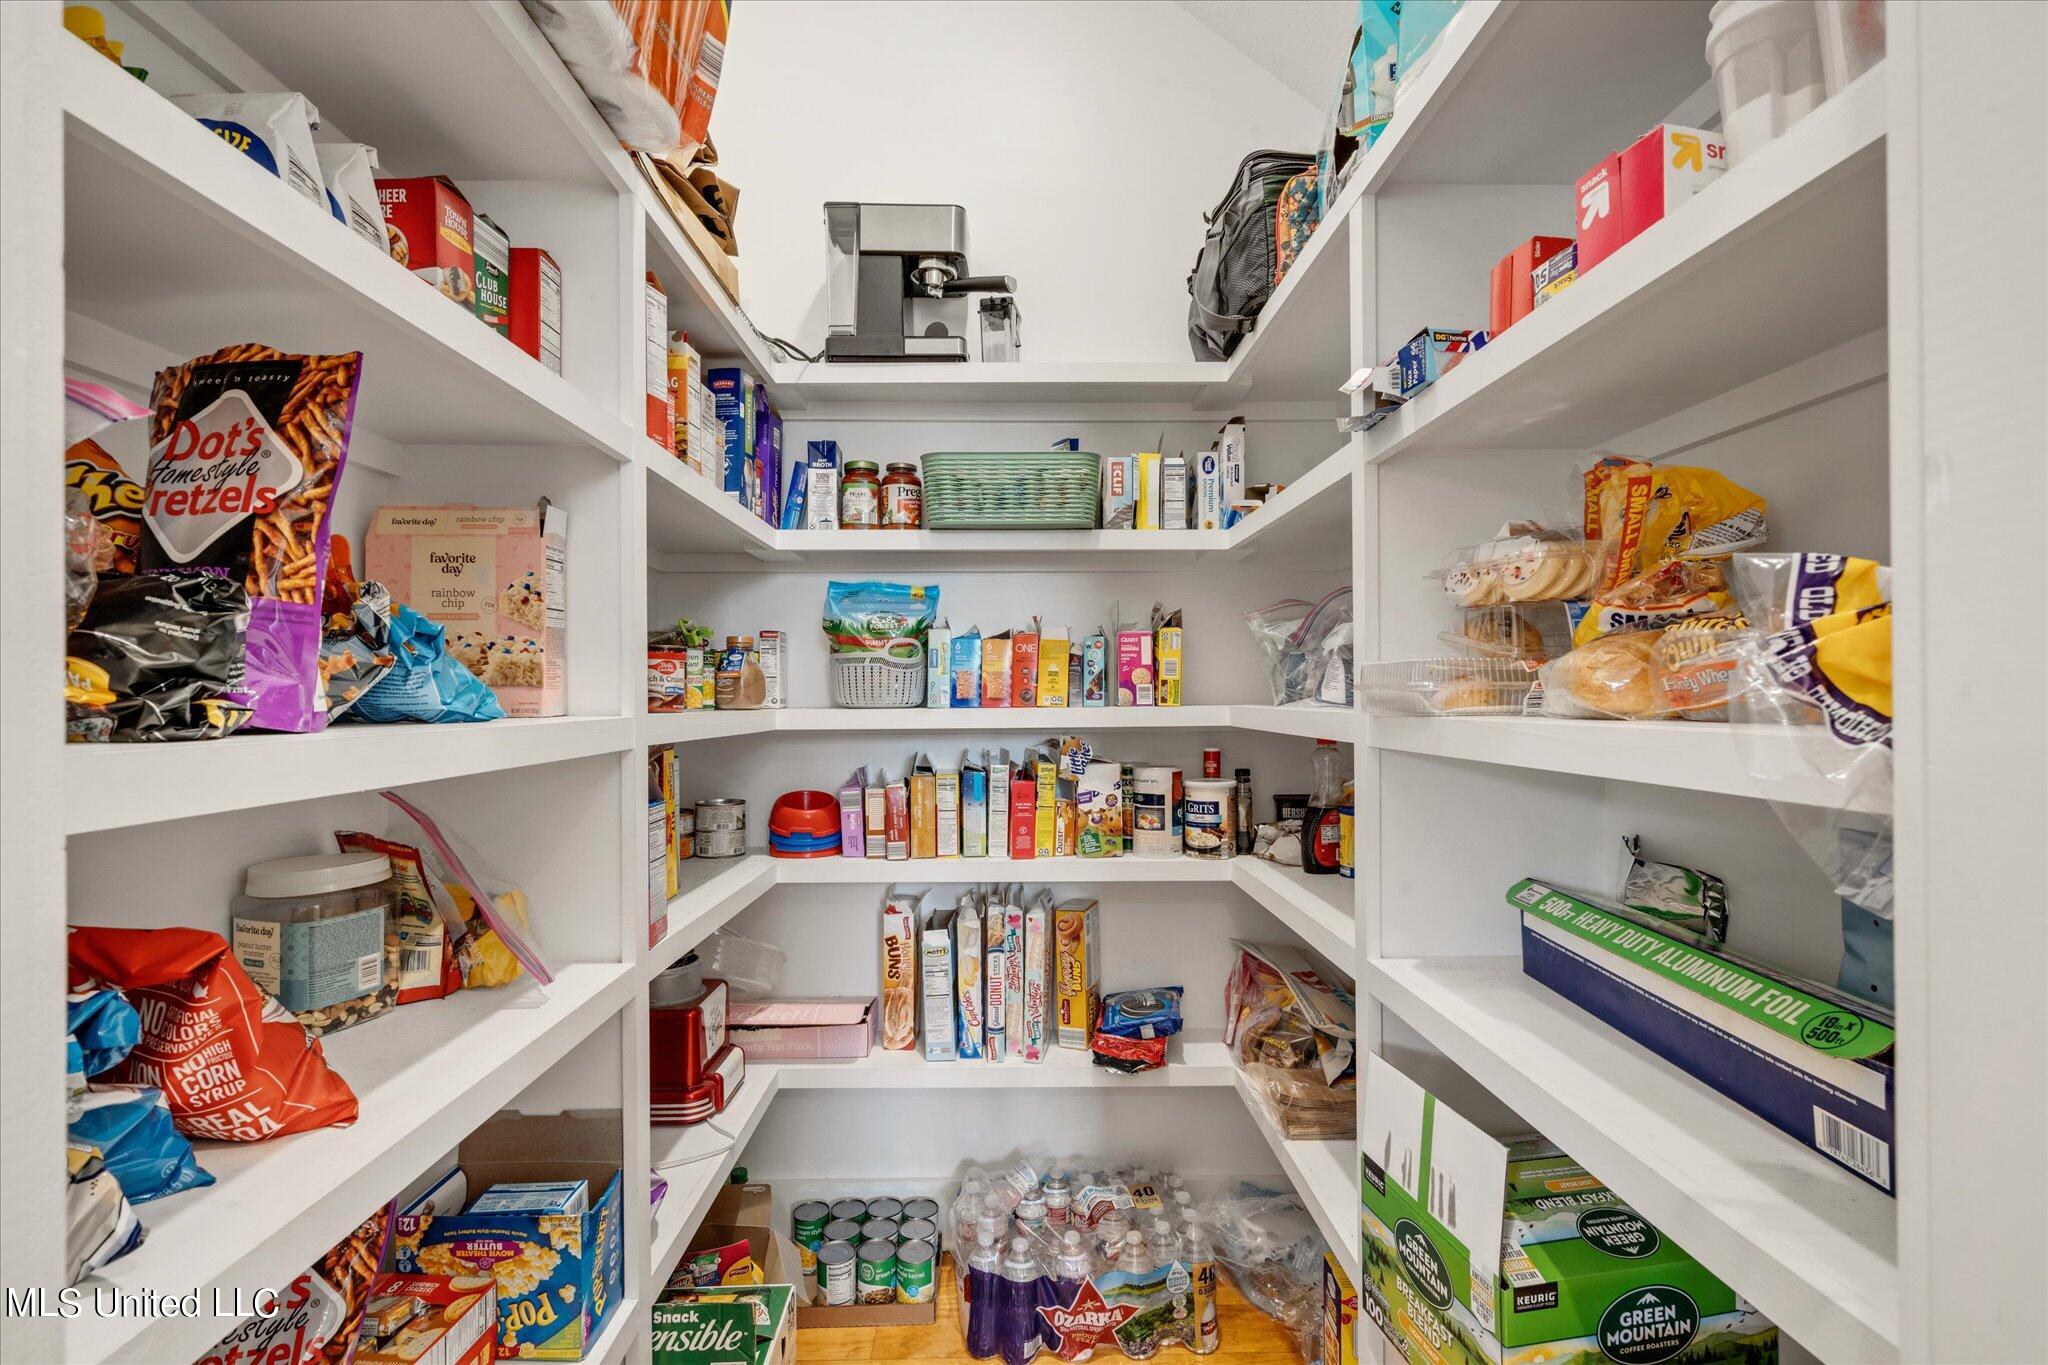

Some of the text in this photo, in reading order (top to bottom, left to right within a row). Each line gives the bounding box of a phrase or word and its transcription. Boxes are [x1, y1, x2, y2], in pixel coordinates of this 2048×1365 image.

[1580, 167, 1608, 193] snack
[444, 205, 468, 228] TOWN
[444, 216, 469, 240] HOUSE
[476, 271, 498, 292] CLUB
[480, 289, 507, 309] HOUSE
[1435, 333, 1468, 342] DG home
[248, 373, 291, 383] toasty
[1411, 360, 1419, 385] Paper
[165, 416, 265, 461] Dot's
[151, 446, 261, 490] Homestyle
[1113, 469, 1123, 495] CLIF
[391, 517, 437, 528] favorite day
[456, 515, 505, 526] rainbow chip
[1622, 483, 1649, 546] SMALL
[430, 551, 477, 565] favorite
[441, 562, 465, 577] day
[431, 587, 476, 599] rainbow
[441, 597, 465, 611] chip
[1799, 585, 1836, 621] OLD
[1015, 643, 1037, 652] ONE
[1068, 748, 1085, 776] Little
[1187, 802, 1216, 814] GRITS
[848, 813, 859, 831] Keto
[1056, 830, 1064, 854] QUEST
[885, 934, 902, 981] BUNS
[899, 941, 912, 974] Honey
[926, 948, 948, 956] MOTT'S
[1059, 950, 1078, 997] Honey
[1071, 961, 1083, 993] BUNS
[1572, 911, 1624, 939] HEAVY
[1612, 929, 1665, 957] DUTY
[1652, 945, 1763, 1002] ALUMINUM
[1751, 988, 1811, 1026] FOIL
[989, 954, 1003, 1027] Glazed DONUT STICKS
[139, 997, 167, 1036] NO
[167, 1006, 221, 1026] ARTIFICIAL
[163, 1016, 223, 1042] COLORS
[205, 1040, 233, 1059] HIGH
[206, 1052, 234, 1065] FRUCTOSE
[172, 1048, 206, 1080] NO
[181, 1060, 242, 1096] CORN
[188, 1080, 247, 1108] SYRUP
[188, 1100, 272, 1133] REAL
[1133, 1186, 1155, 1198] 40
[1535, 1195, 1575, 1212] BLEND
[1582, 1220, 1648, 1238] MOUNTAIN
[1602, 1231, 1646, 1247] GREEN
[455, 1249, 515, 1257] MOVIE THEATER
[466, 1242, 503, 1250] BUTTER
[1405, 1233, 1438, 1274] GREEN
[1398, 1239, 1449, 1300] MOUNTAIN
[386, 1280, 404, 1293] 8
[1364, 1291, 1384, 1327] 100
[1516, 1291, 1557, 1306] KEURIG
[652, 1310, 700, 1324] Snack
[1053, 1308, 1123, 1328] OZARKA
[1396, 1274, 1454, 1348] BREAKFAST
[1619, 1304, 1676, 1327] GREEN
[652, 1318, 744, 1352] ensible
[1407, 1303, 1442, 1350] BLEND
[1606, 1319, 1692, 1347] MOUNTAIN
[497, 1347, 511, 1357] 12
[1619, 1339, 1680, 1355] COFFEE ROASTERS
